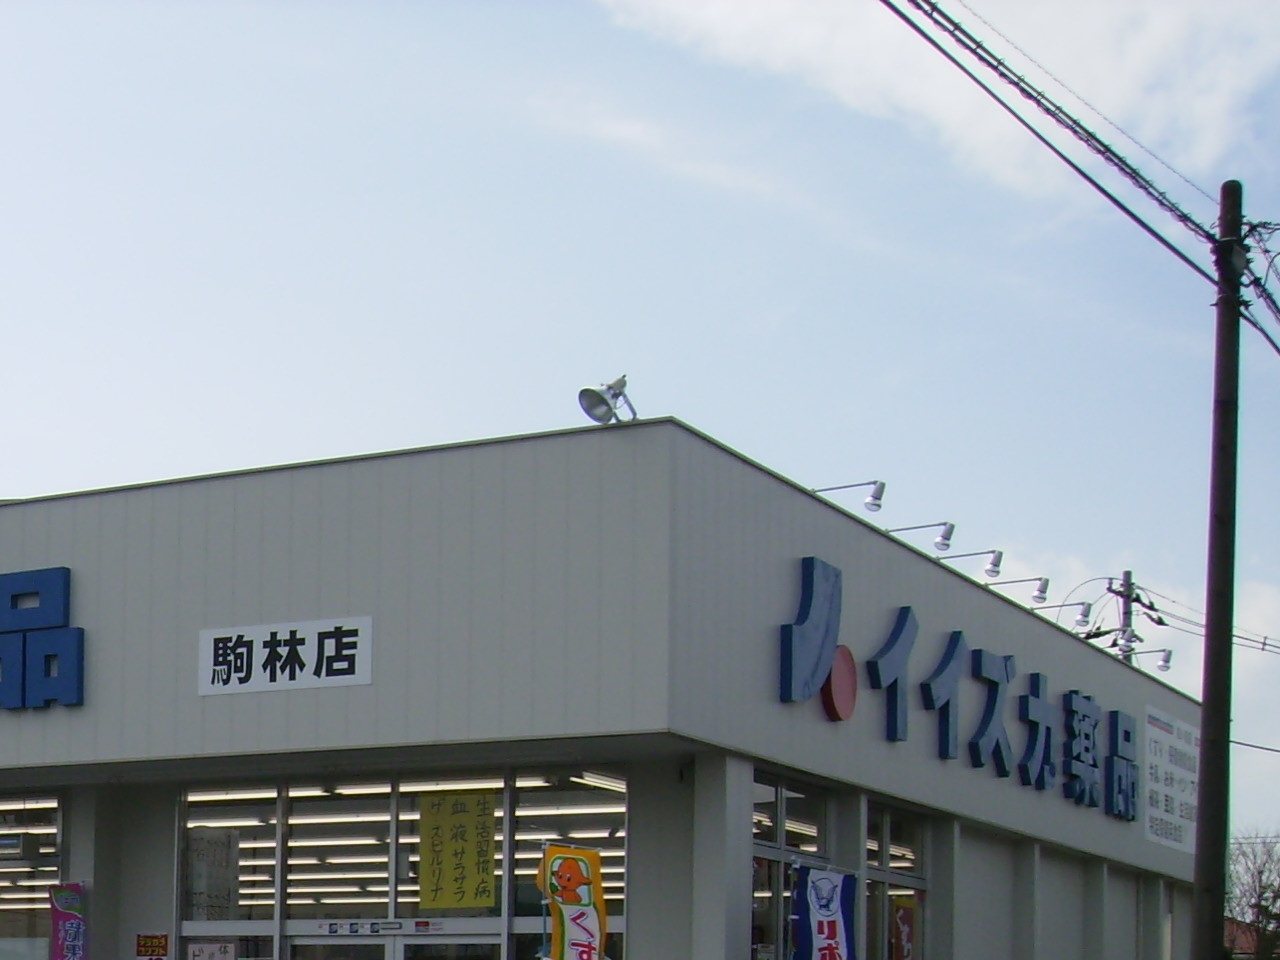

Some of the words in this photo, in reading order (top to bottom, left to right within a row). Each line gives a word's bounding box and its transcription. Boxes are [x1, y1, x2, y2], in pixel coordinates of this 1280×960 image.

[211, 626, 359, 687] 駒林店
[865, 604, 1140, 822] イイズカ薬品
[450, 799, 470, 903] 血液サラサラ
